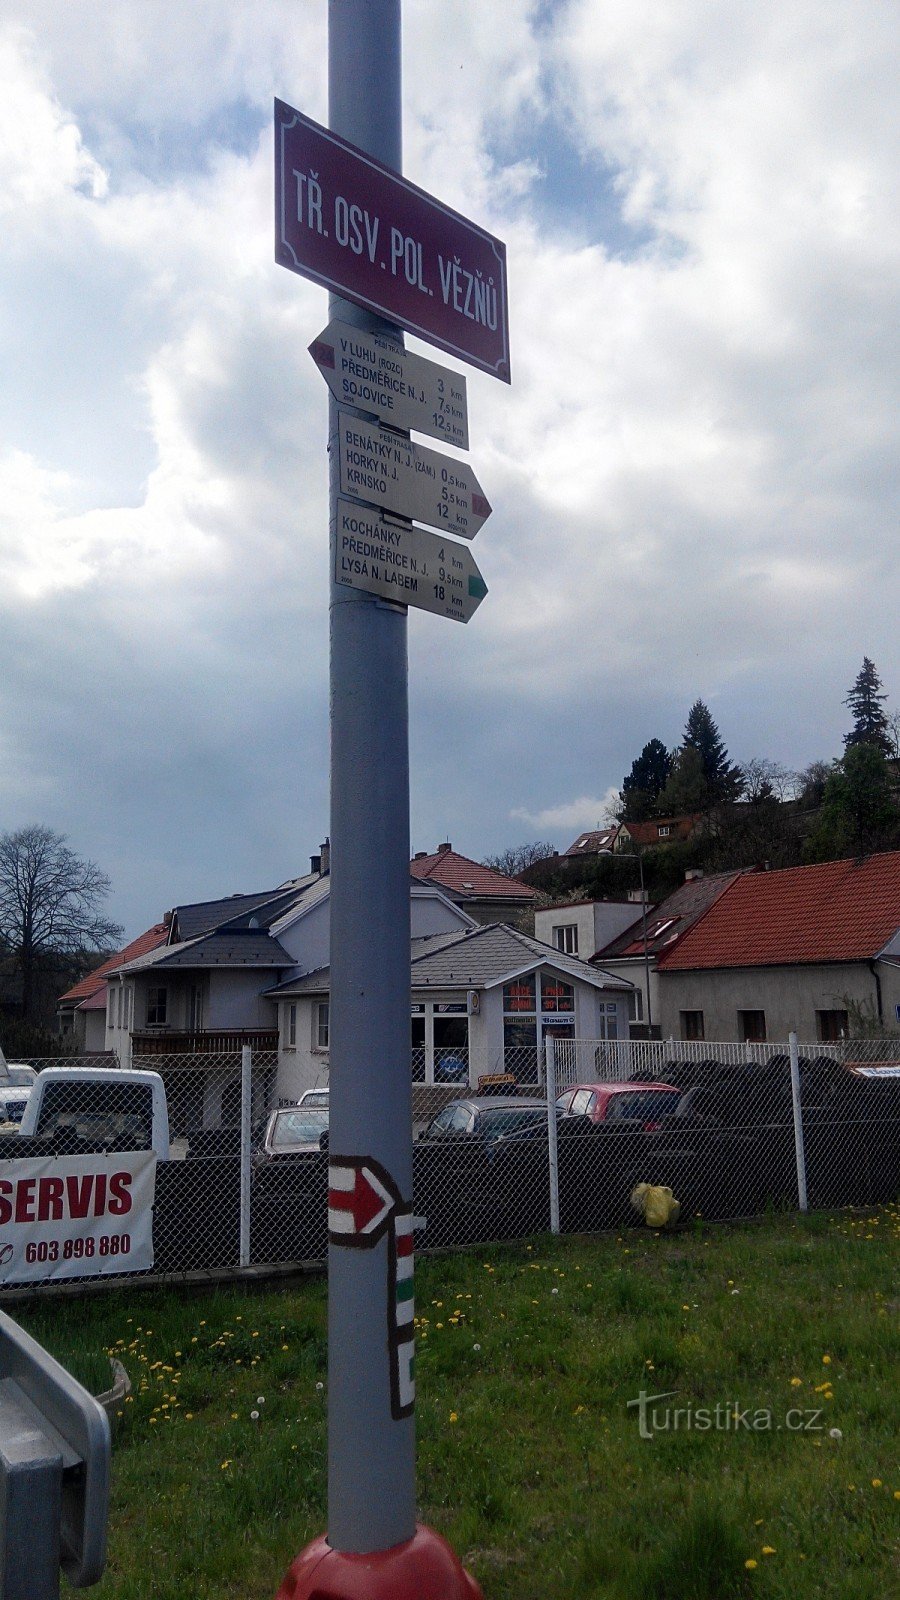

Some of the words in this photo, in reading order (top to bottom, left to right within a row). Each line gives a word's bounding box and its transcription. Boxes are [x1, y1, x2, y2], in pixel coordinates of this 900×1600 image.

[292, 168, 329, 238] TŘ.
[334, 196, 386, 270] OSV.
[391, 226, 434, 297] POL.
[438, 254, 498, 331] VĚZŇŮ
[340, 338, 347, 352] V
[349, 341, 376, 364] LUHU
[437, 378, 444, 393] 3
[450, 387, 462, 400] km
[341, 357, 406, 396] PŘEDMĚŘICE
[408, 385, 417, 400] N.
[419, 390, 427, 404] J.
[451, 404, 463, 419] km
[342, 378, 394, 410] SOJOVICE
[432, 412, 451, 432] 12,5
[452, 422, 464, 437] km
[346, 430, 392, 460] BENÁTKY
[394, 451, 404, 464] N.
[405, 454, 413, 468] J.
[455, 475, 467, 490] km
[346, 449, 378, 472] HORKY
[380, 465, 390, 477] N.
[391, 467, 399, 481] J.
[455, 494, 468, 508] km
[347, 467, 386, 493] KRNSKO
[437, 502, 449, 519] 12
[456, 511, 468, 526] km
[342, 515, 401, 546] KOCHÁNKY
[438, 548, 445, 563] 4
[452, 557, 463, 570] km
[342, 536, 408, 569] PŘEDMĚŘICE
[410, 558, 419, 573] N.
[421, 563, 429, 577] J.
[341, 556, 368, 576] LYSÁ
[371, 566, 381, 581] N.
[384, 569, 418, 592] LABEM
[433, 584, 445, 601] 18
[451, 595, 463, 607] km
[26, 1240, 59, 1264] 603
[63, 1236, 95, 1259] 898
[99, 1233, 131, 1256] 880
